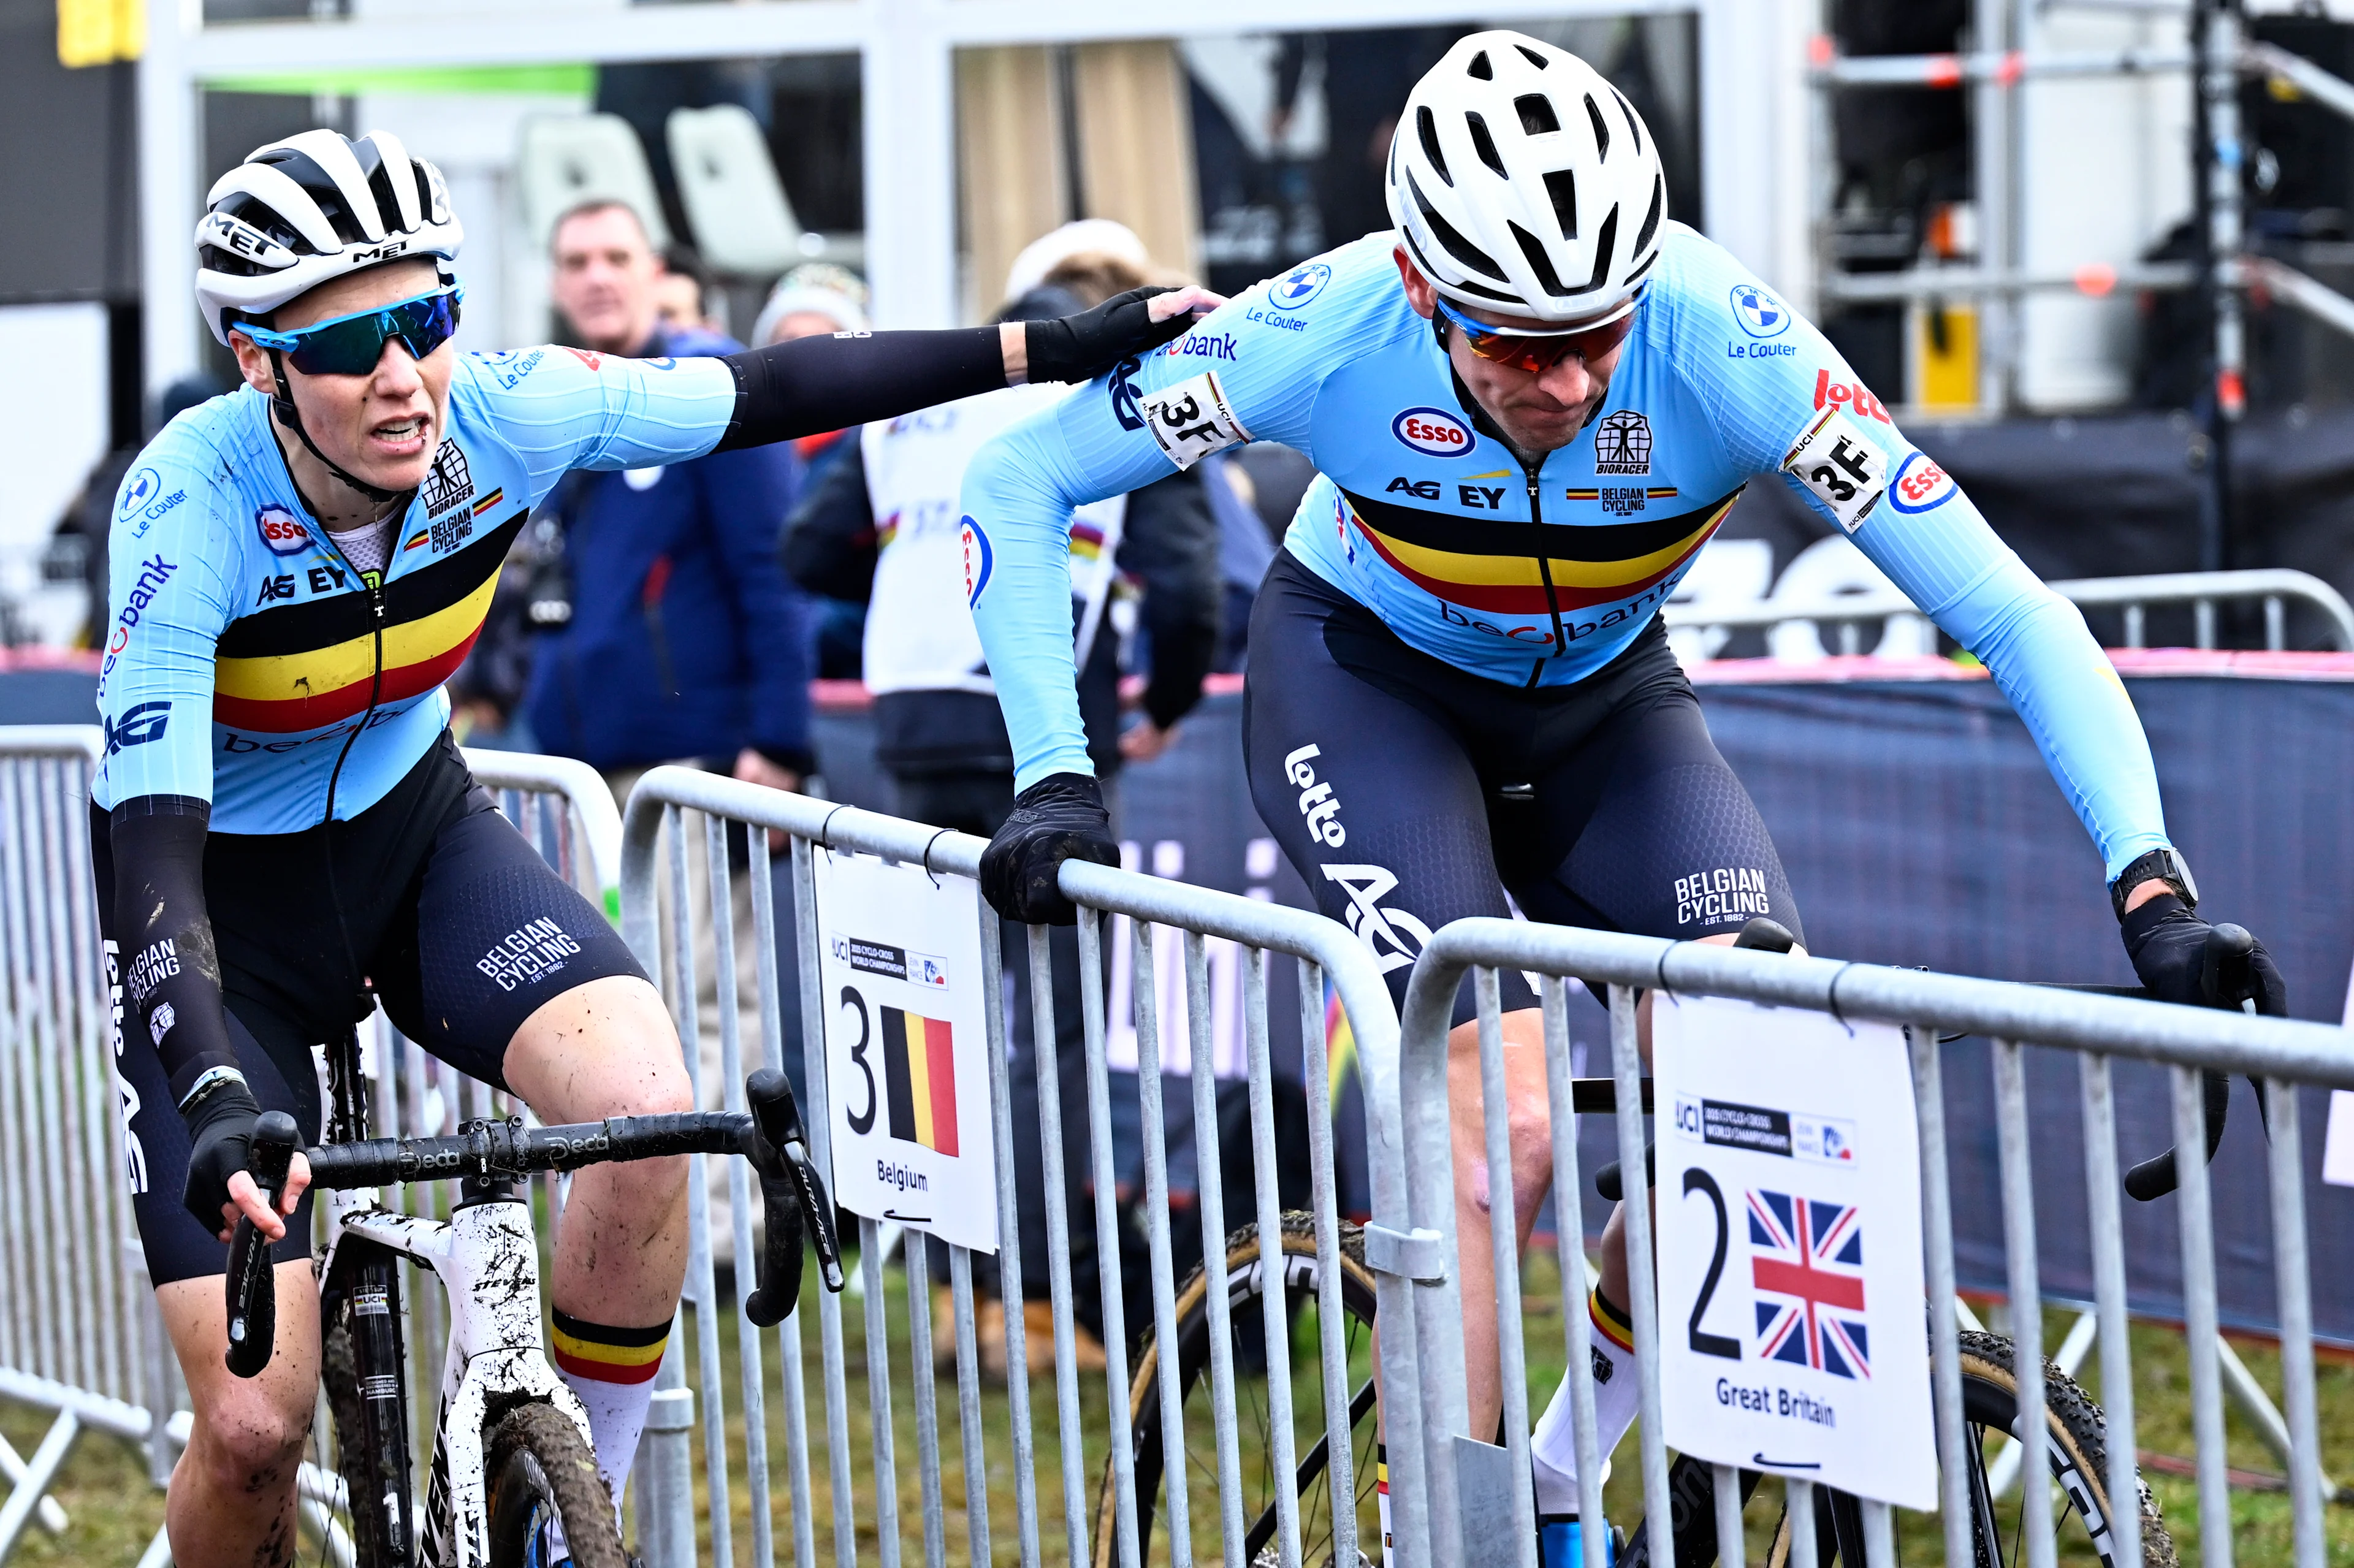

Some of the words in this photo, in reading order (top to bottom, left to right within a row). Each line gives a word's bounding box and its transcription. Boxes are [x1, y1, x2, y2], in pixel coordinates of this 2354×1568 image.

[207, 213, 280, 257] MET
[352, 240, 406, 264] MET
[1246, 307, 1263, 322] Le
[1265, 311, 1308, 332] Couter
[1728, 341, 1745, 358] Le
[1749, 343, 1797, 358] Couter
[498, 374, 519, 390] Le
[1161, 395, 1227, 442] 3F
[1217, 403, 1231, 422] UCI
[1406, 418, 1464, 445] Esso
[1796, 433, 1813, 452] UCI
[1596, 464, 1649, 474] BIORACER
[1811, 435, 1871, 501] 3F
[429, 484, 474, 520] BIORACER
[1385, 477, 1442, 500] AG
[1458, 485, 1507, 509] EY
[1602, 487, 1644, 500] BELGIAN
[1602, 500, 1645, 512] CYCLING
[132, 521, 150, 539] Le
[145, 489, 188, 520] Couter
[431, 506, 471, 541] BELGIAN
[1851, 515, 1861, 527] UCI
[432, 521, 472, 554] CYCLING
[256, 574, 295, 607] AG
[307, 566, 346, 594] EY
[1437, 571, 1680, 644] beobank
[100, 554, 178, 697] beobank
[1284, 742, 1346, 848] lotto
[1674, 868, 1766, 904] BELGIAN
[1678, 892, 1770, 924] CYCLING
[1705, 915, 1722, 926] EST.
[1724, 913, 1744, 922] 1882
[476, 916, 563, 978] BELGIAN
[495, 934, 581, 992] CYCLING
[834, 938, 848, 961] UCI
[861, 945, 894, 961] CYCLO-CROSS
[531, 970, 547, 984] EST.
[545, 961, 565, 975] 1882
[851, 954, 869, 966] WORLD
[869, 957, 905, 975] CHAMPIONSHIPS
[840, 985, 877, 1135] 3
[877, 1159, 928, 1192] Belgium
[798, 1165, 832, 1257] DURA-ACE
[238, 1227, 259, 1309] URA-ACE
[1683, 1166, 1742, 1361] 2
[364, 1295, 381, 1304] UCI
[1717, 1377, 1771, 1414] Great
[1779, 1388, 1836, 1428] Britain
